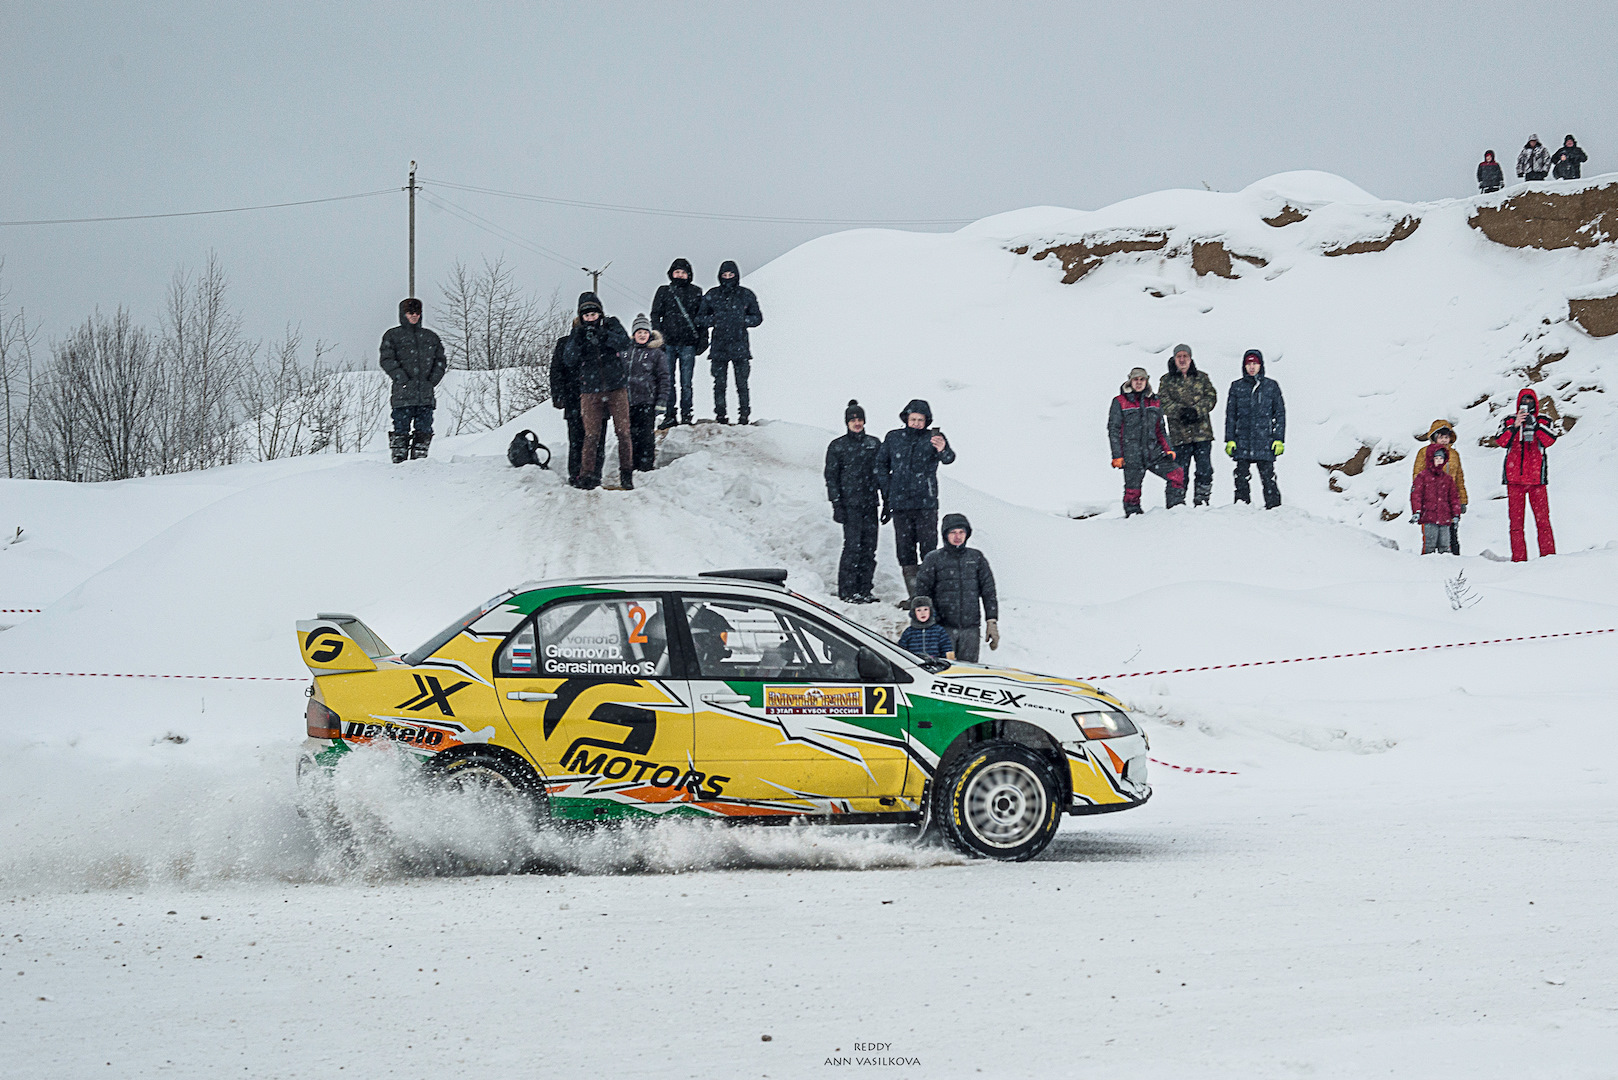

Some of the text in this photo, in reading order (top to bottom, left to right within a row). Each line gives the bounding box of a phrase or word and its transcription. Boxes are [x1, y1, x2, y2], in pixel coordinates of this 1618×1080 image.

[628, 606, 648, 643] 2
[545, 644, 624, 659] Gromov D.
[544, 659, 658, 675] Gerasimenko S.
[872, 687, 888, 714] 2
[1023, 702, 1066, 715] race-x.ru
[345, 720, 444, 745] pakelo
[567, 749, 731, 799] MOTORS
